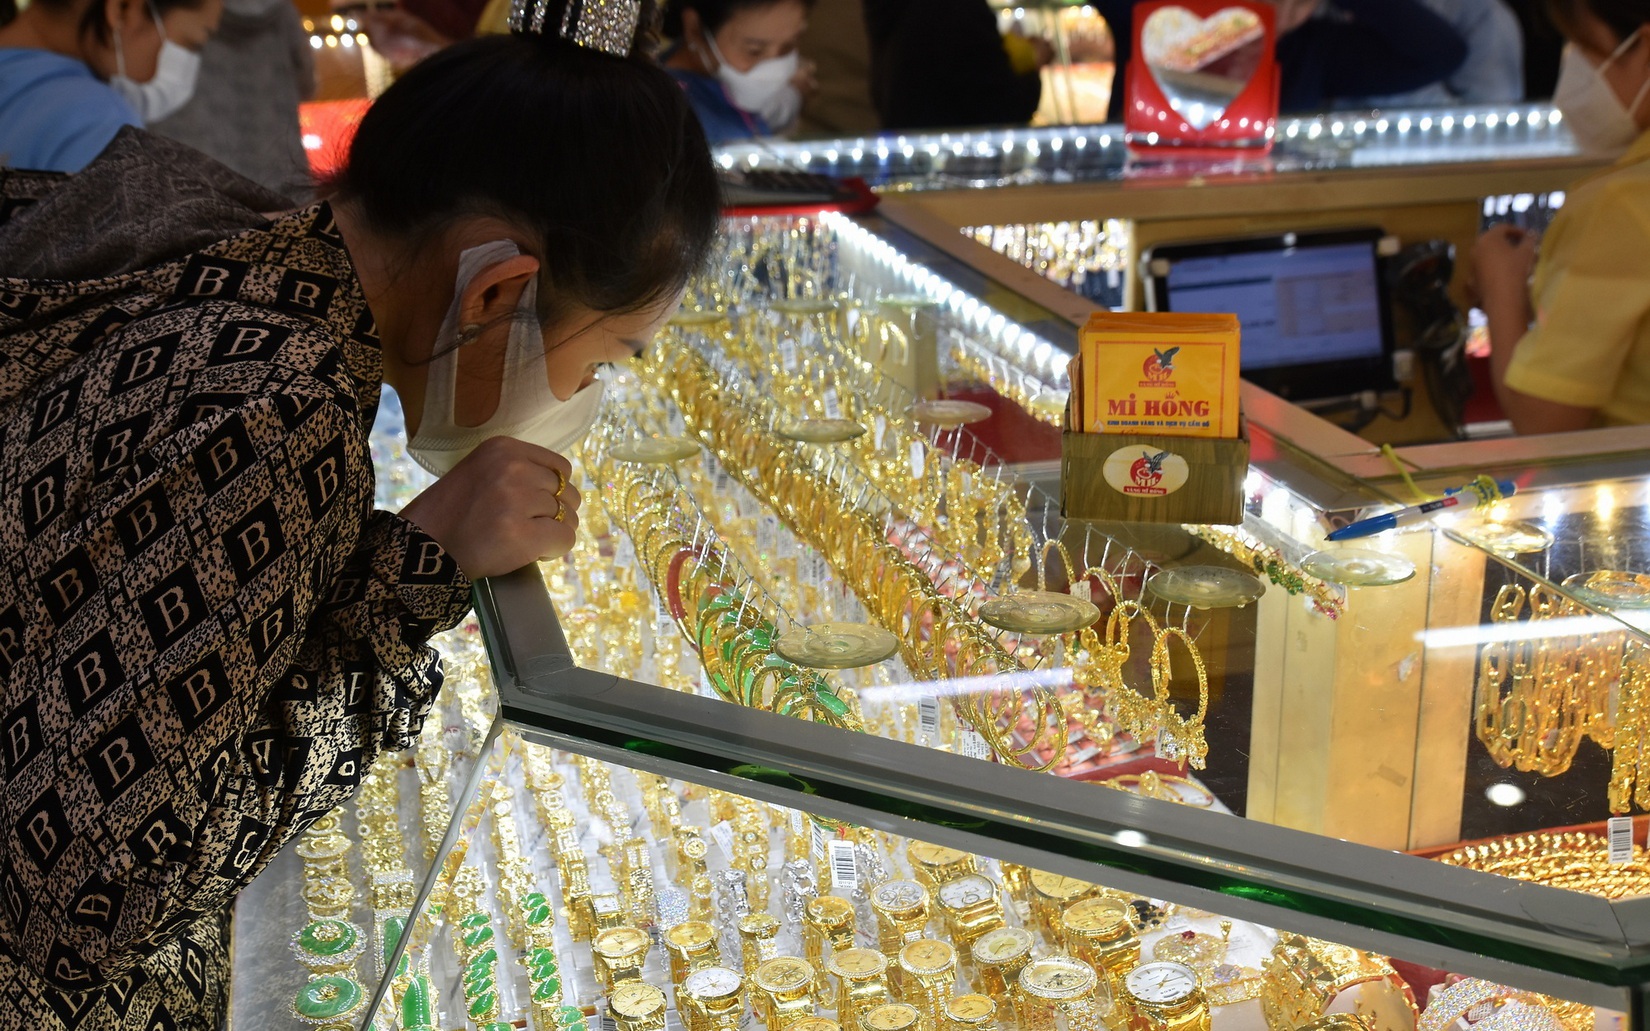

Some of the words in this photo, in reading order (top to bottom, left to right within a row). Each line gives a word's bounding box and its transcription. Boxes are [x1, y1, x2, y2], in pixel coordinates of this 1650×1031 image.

[188, 265, 230, 297] B
[289, 280, 321, 309] B
[122, 345, 162, 386] B
[223, 327, 271, 358] B
[37, 389, 70, 432] B
[100, 427, 133, 472] B
[207, 435, 239, 482] B
[31, 475, 55, 526] B
[314, 456, 339, 508] B
[127, 499, 158, 547] B
[238, 519, 270, 572] B
[412, 541, 446, 576] B
[50, 567, 84, 612] B
[154, 585, 190, 637] B
[326, 578, 360, 605] B
[261, 607, 284, 652] B
[73, 650, 107, 703] B
[182, 668, 217, 718] B
[8, 716, 30, 768] B
[99, 736, 136, 789] B
[26, 810, 58, 861] B
[5, 873, 23, 924] B
